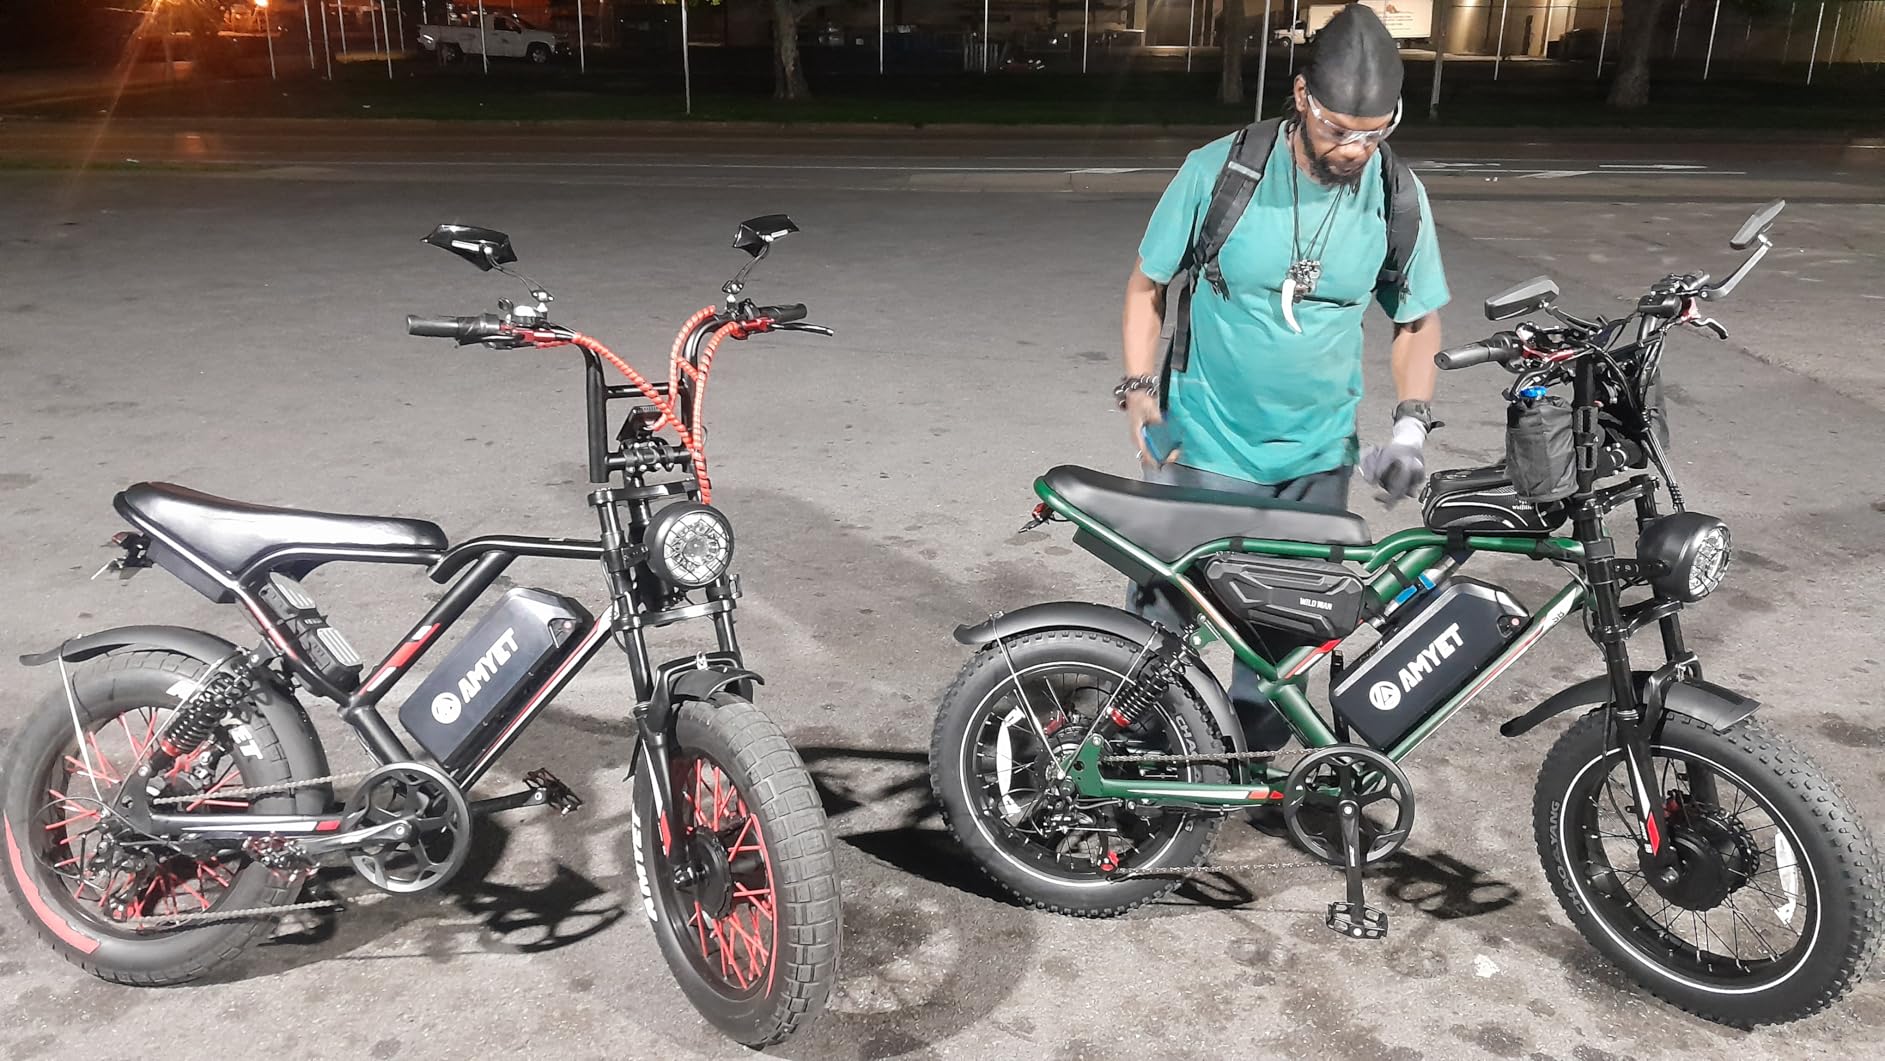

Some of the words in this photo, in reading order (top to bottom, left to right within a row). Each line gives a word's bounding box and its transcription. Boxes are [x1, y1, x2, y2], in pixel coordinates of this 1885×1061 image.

[1299, 597, 1317, 608] WILD
[457, 627, 519, 704] AMYET
[1398, 622, 1464, 693] AMYET
